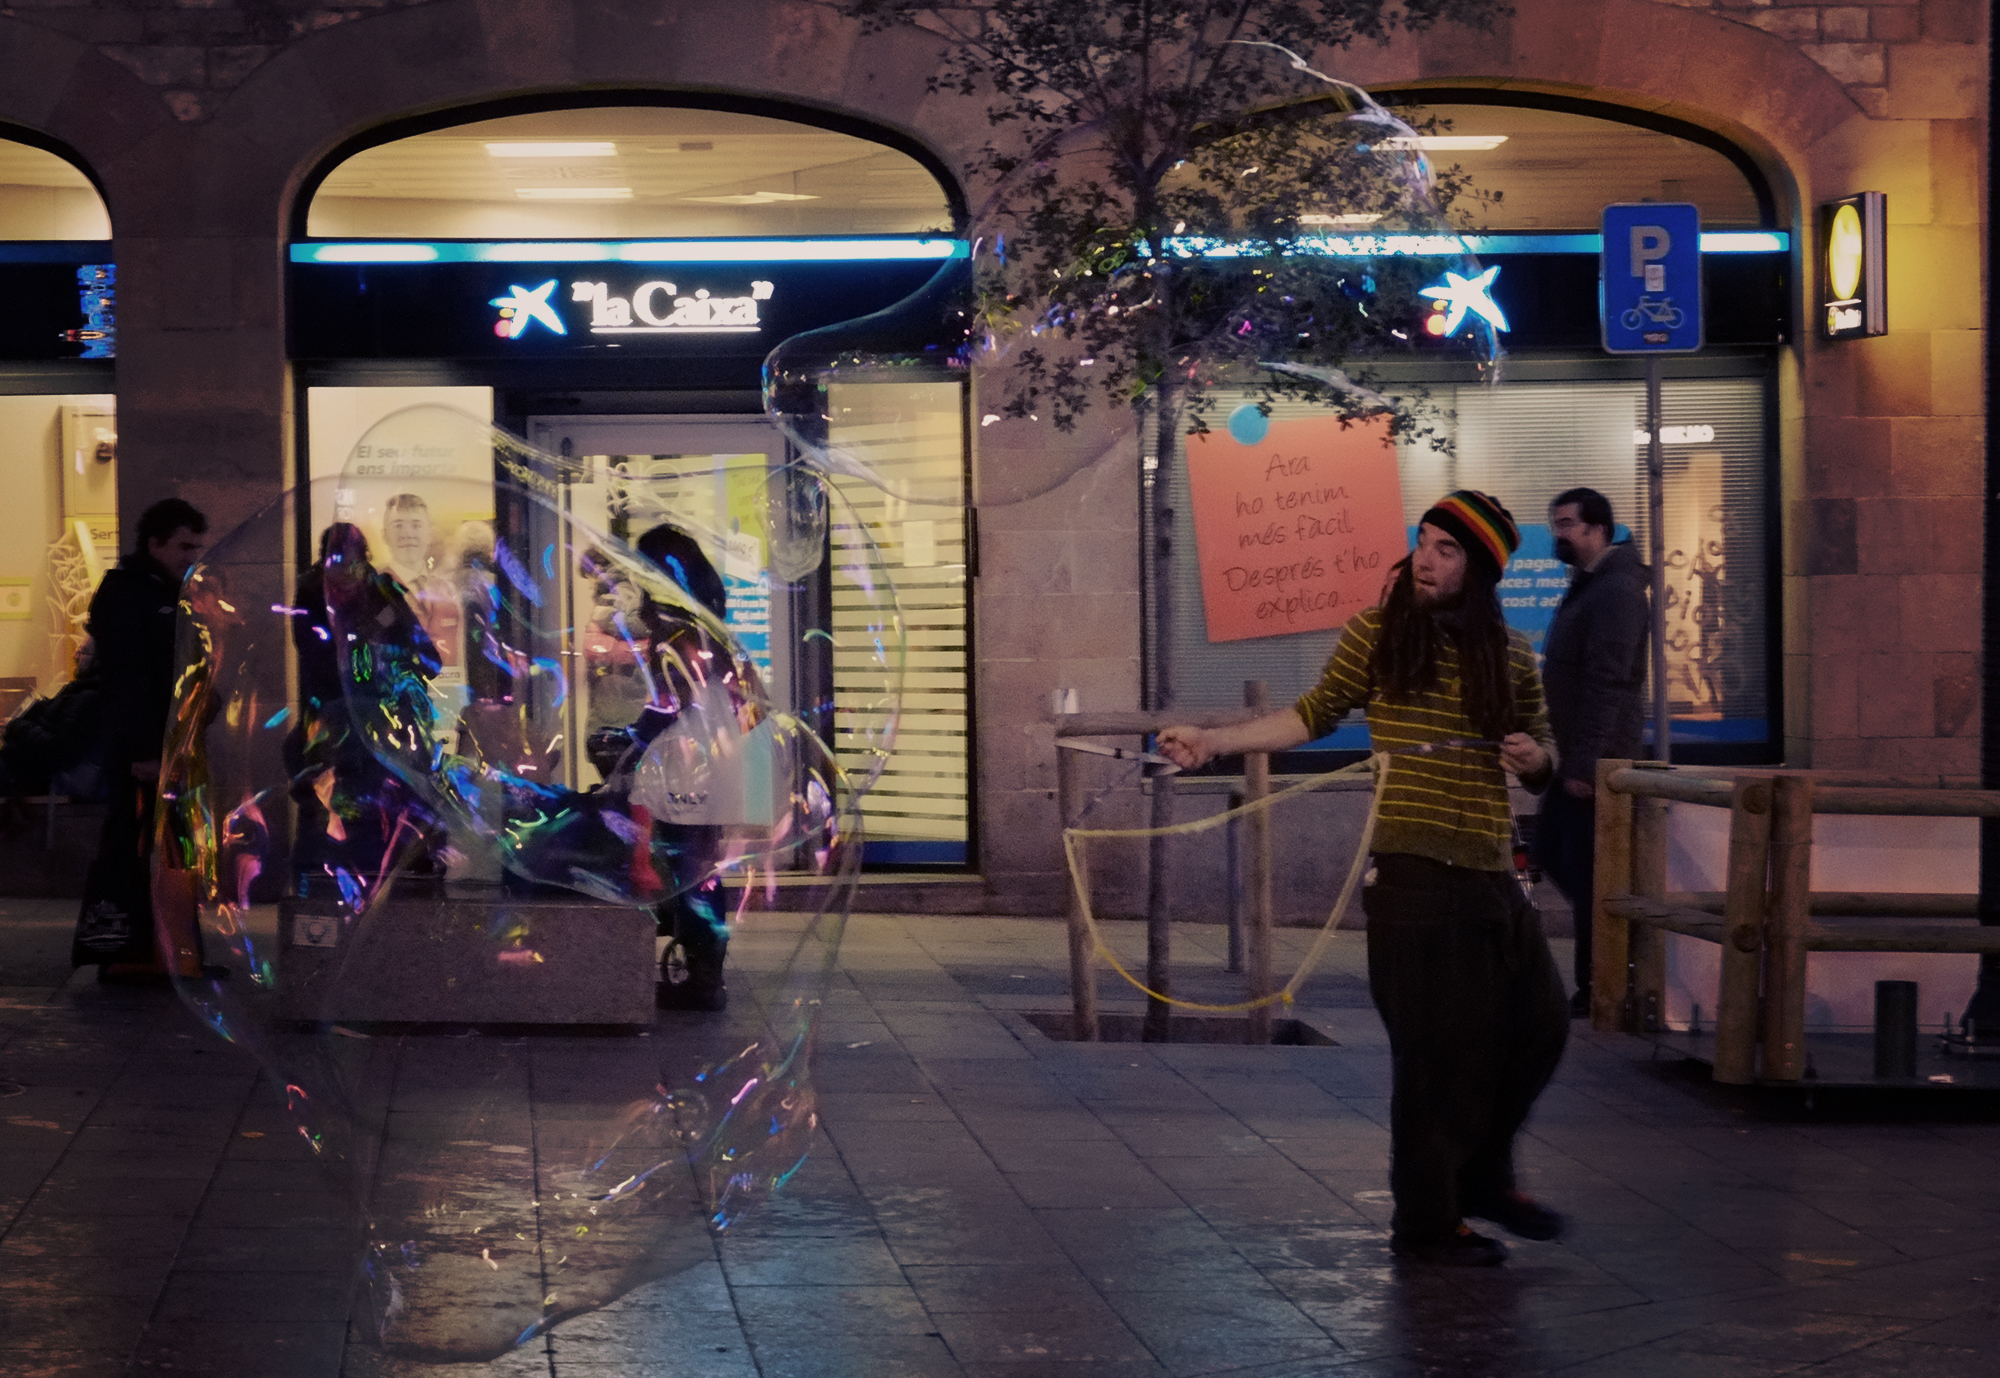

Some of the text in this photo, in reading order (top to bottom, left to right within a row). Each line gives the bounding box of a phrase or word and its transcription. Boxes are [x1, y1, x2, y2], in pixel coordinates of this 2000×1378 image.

[1629, 225, 1671, 277] P
[356, 464, 386, 476] ens
[1264, 452, 1311, 482] Ara
[1235, 482, 1350, 518] ho tenim
[90, 528, 119, 541] Ser
[1238, 521, 1286, 549] més
[1222, 555, 1326, 593] Després
[1512, 558, 1560, 572] pagar
[1501, 595, 1537, 608] cost
